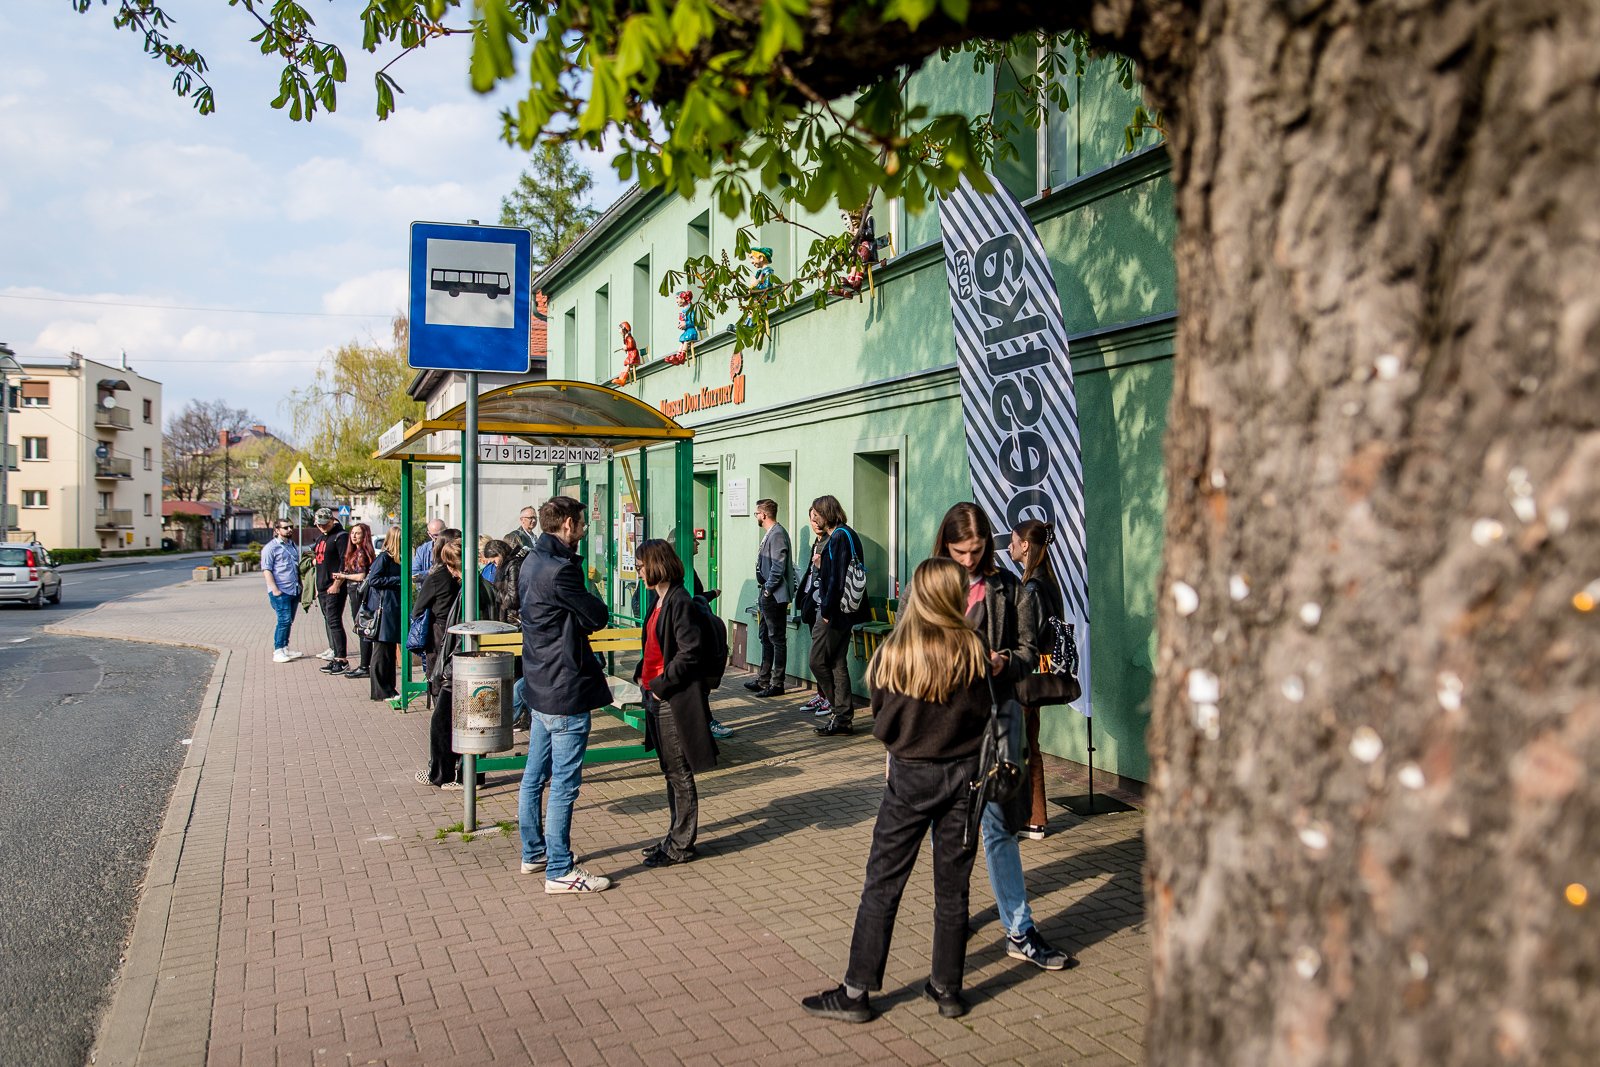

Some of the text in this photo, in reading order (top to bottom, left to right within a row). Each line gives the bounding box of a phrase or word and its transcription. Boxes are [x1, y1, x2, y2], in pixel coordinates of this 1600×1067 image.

[485, 448, 599, 461] 7 9 15 21 22 N1 N2
[725, 453, 736, 470] 172
[1022, 943, 1036, 957] N
